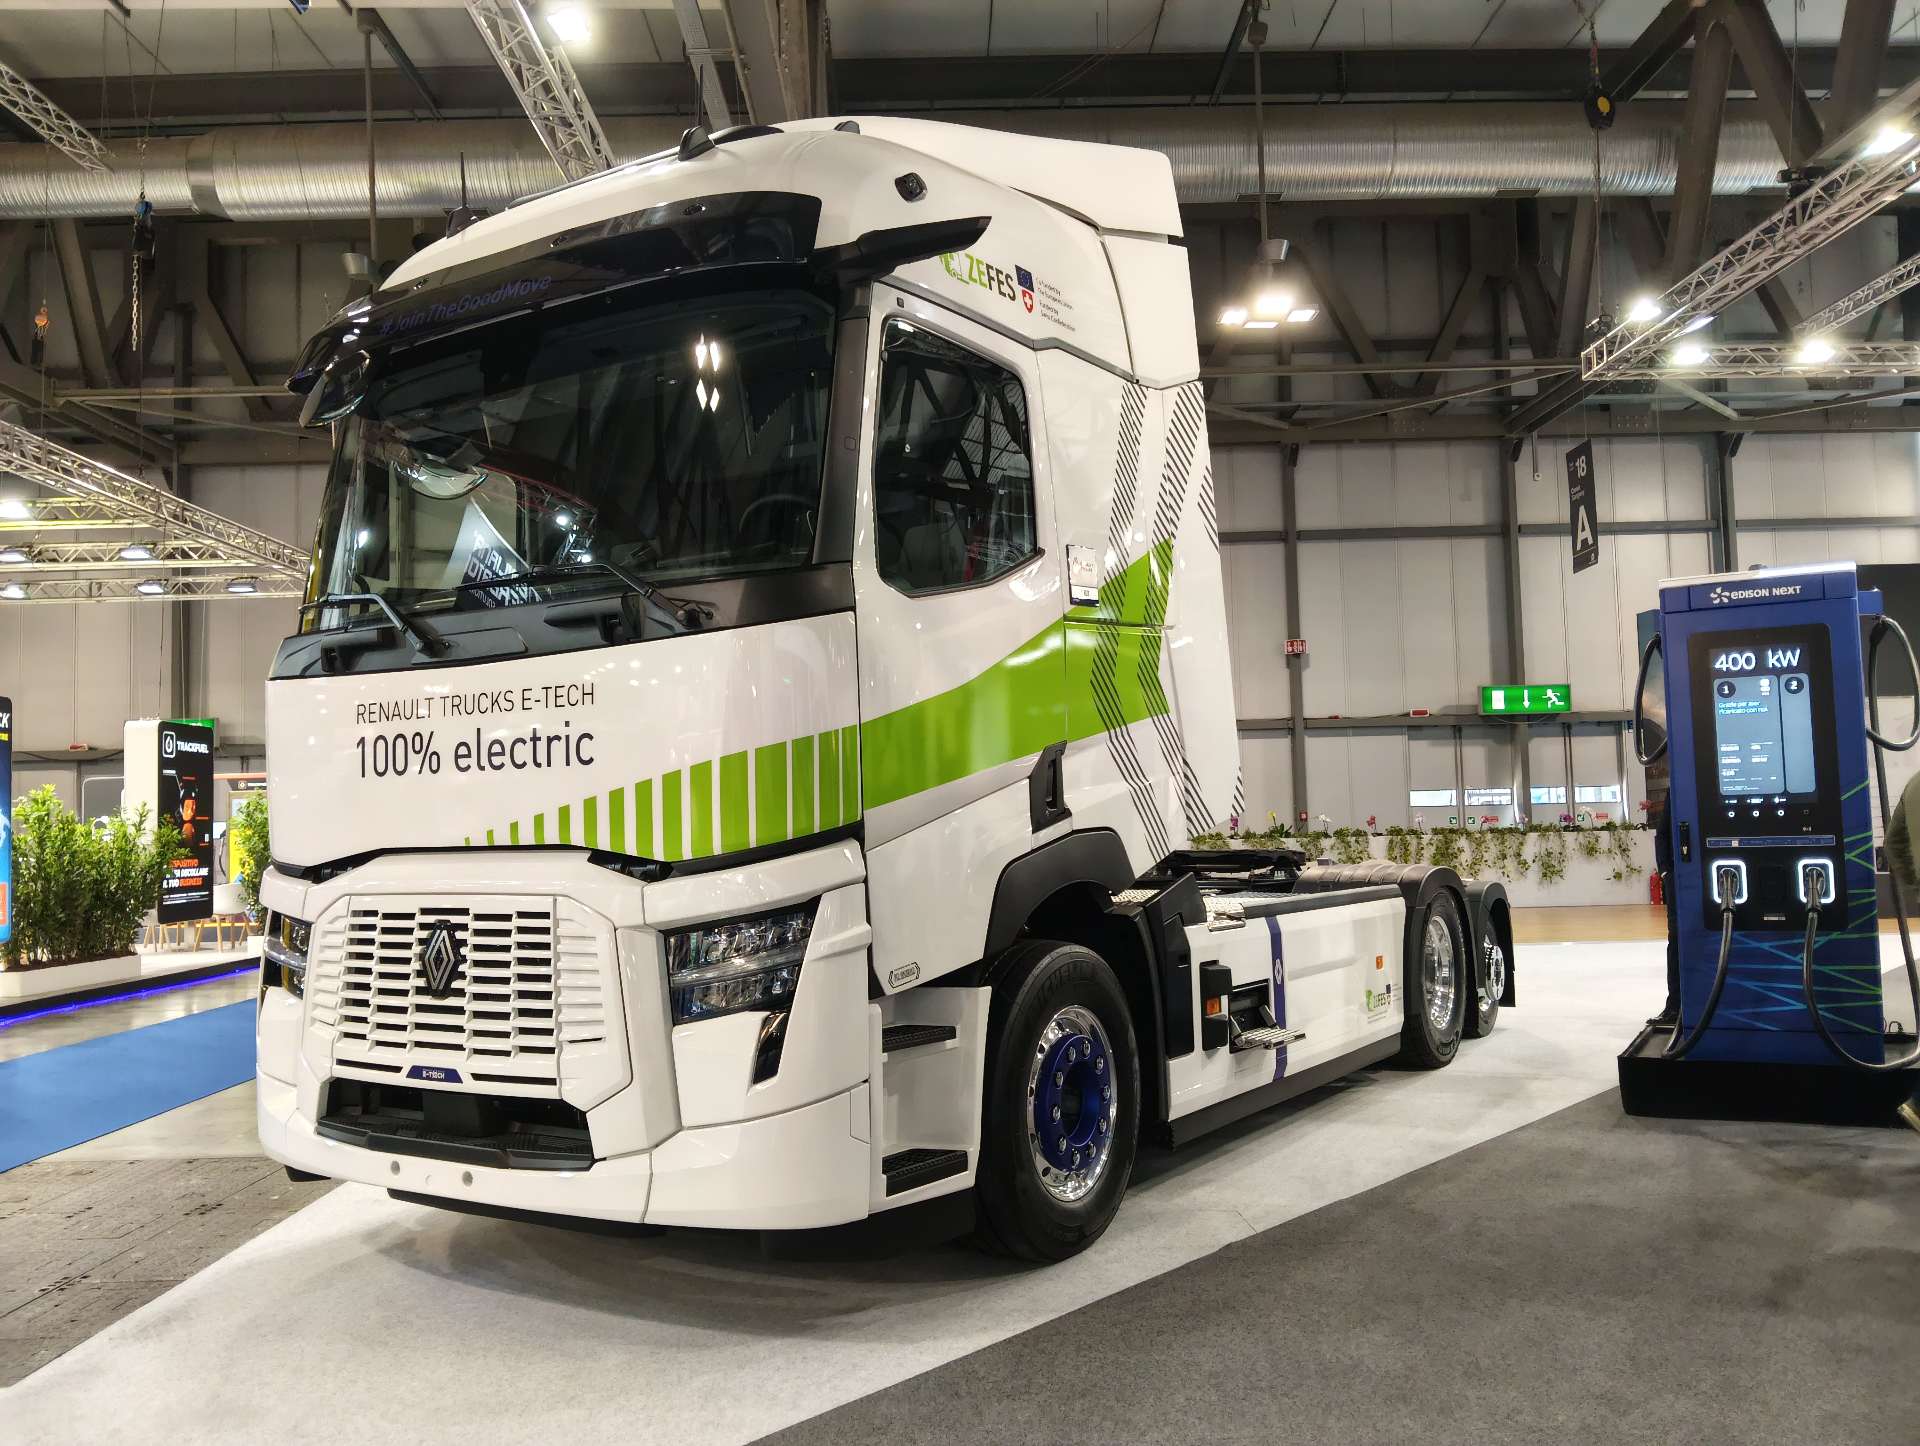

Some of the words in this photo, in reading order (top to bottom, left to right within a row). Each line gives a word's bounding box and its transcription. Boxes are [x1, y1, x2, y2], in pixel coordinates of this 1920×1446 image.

[965, 253, 1017, 301] ZEFES
[379, 275, 552, 336] #JoinTheGoodMove
[1576, 456, 1587, 479] 18
[1577, 504, 1594, 551] A
[1715, 652, 1756, 671] 400
[1767, 647, 1801, 668] kW
[356, 697, 434, 724] RENAULT
[439, 689, 515, 717] TRUCKS
[521, 682, 595, 710] E-TECH
[1722, 685, 1729, 694] 1
[1790, 681, 1797, 690] 2
[356, 730, 441, 778] 100%
[454, 721, 594, 773] electric
